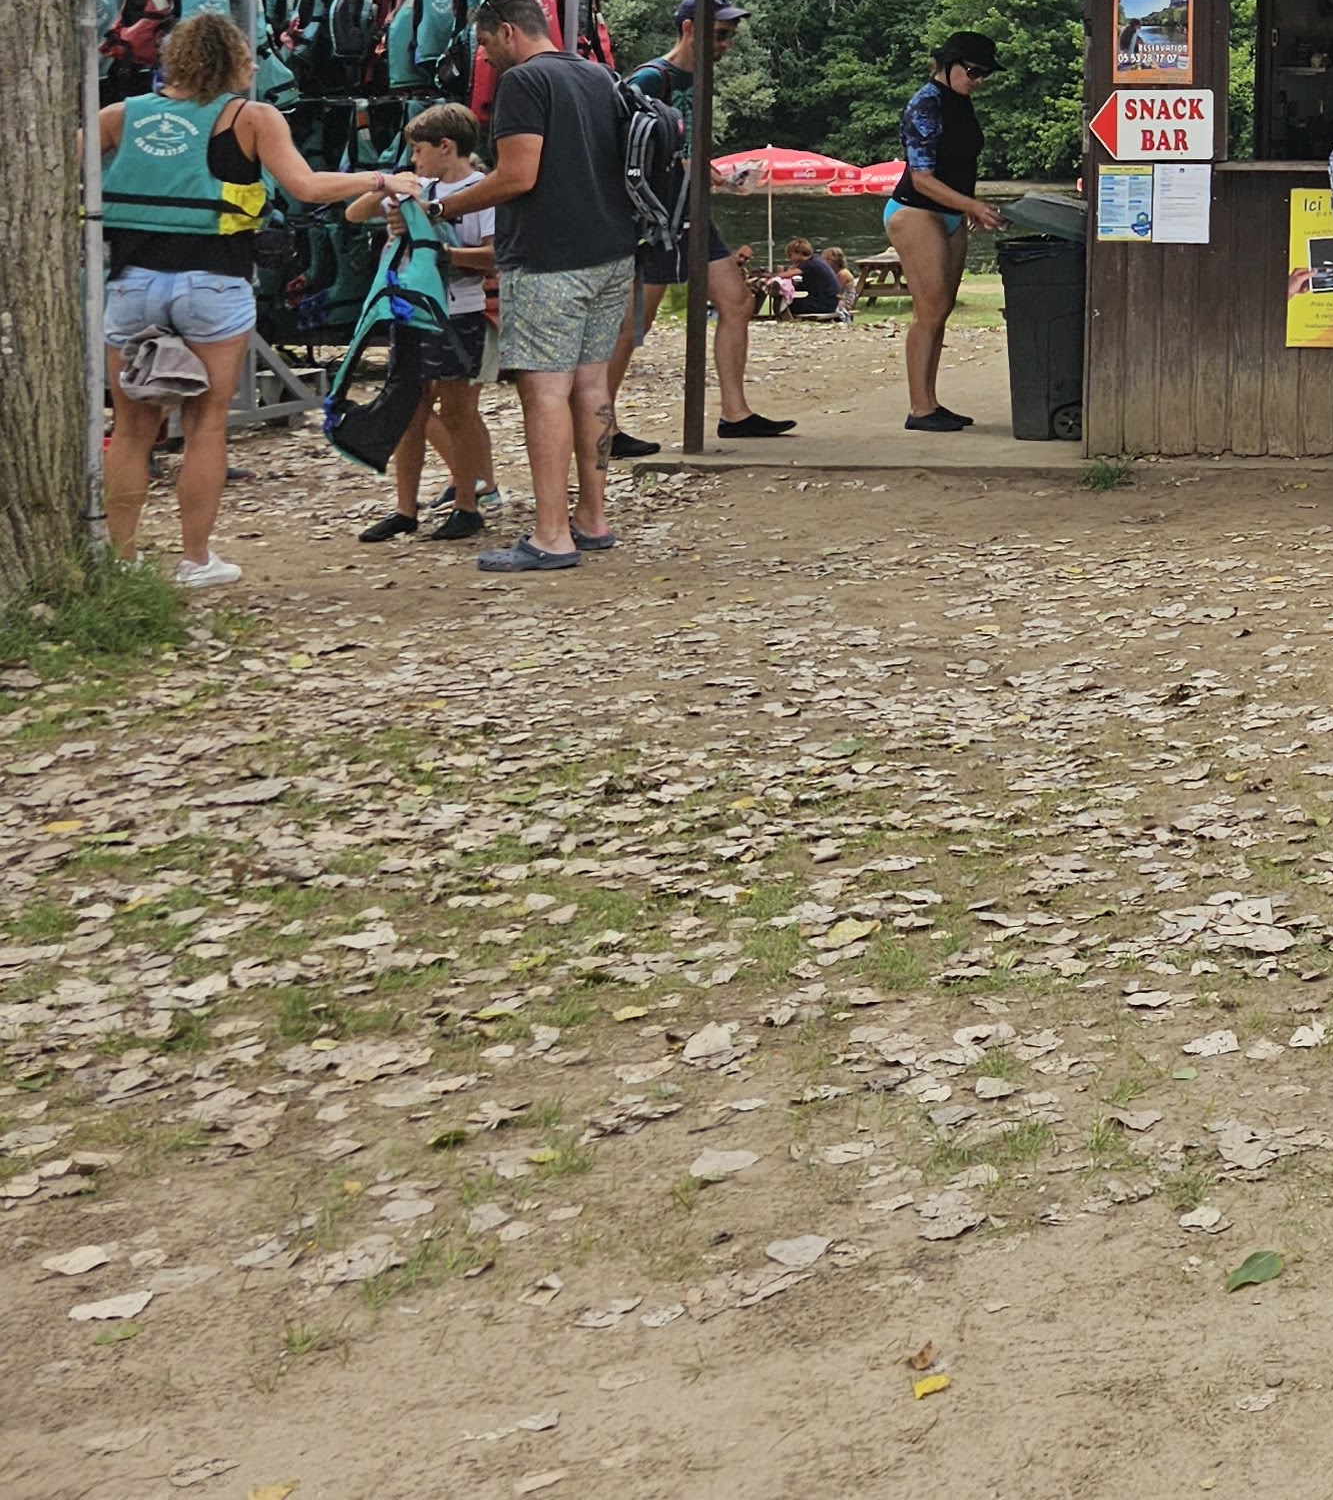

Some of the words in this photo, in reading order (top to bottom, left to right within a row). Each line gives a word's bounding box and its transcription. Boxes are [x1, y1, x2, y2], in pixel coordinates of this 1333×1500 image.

[1118, 53, 1129, 63] 05
[1131, 53, 1141, 63] 53
[1142, 53, 1153, 63] 28
[1156, 53, 1164, 63] 17
[1167, 53, 1177, 63] 07
[1124, 98, 1205, 120] SNACK
[1141, 129, 1189, 151] BAR
[1304, 195, 1323, 211] Ici
